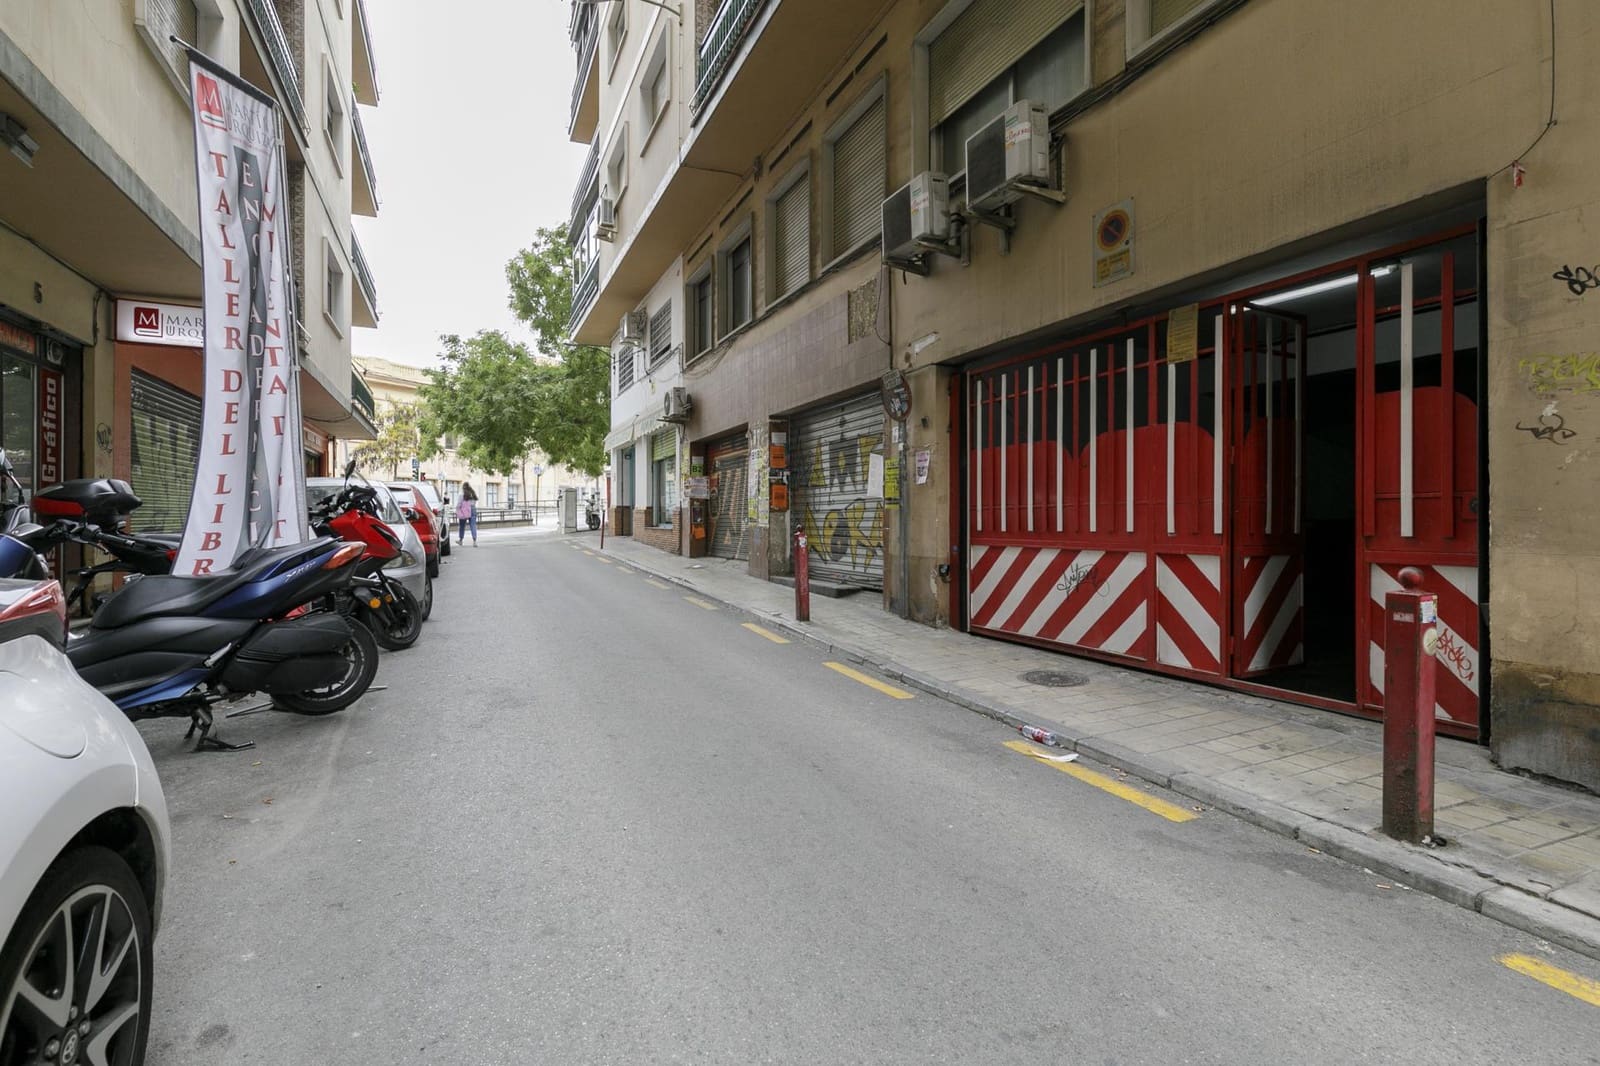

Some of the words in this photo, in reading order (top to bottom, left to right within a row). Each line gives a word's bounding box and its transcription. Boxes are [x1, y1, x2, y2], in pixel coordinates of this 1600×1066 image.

[209, 151, 244, 350] TALLER
[139, 312, 157, 326] M
[221, 369, 243, 456] DEL
